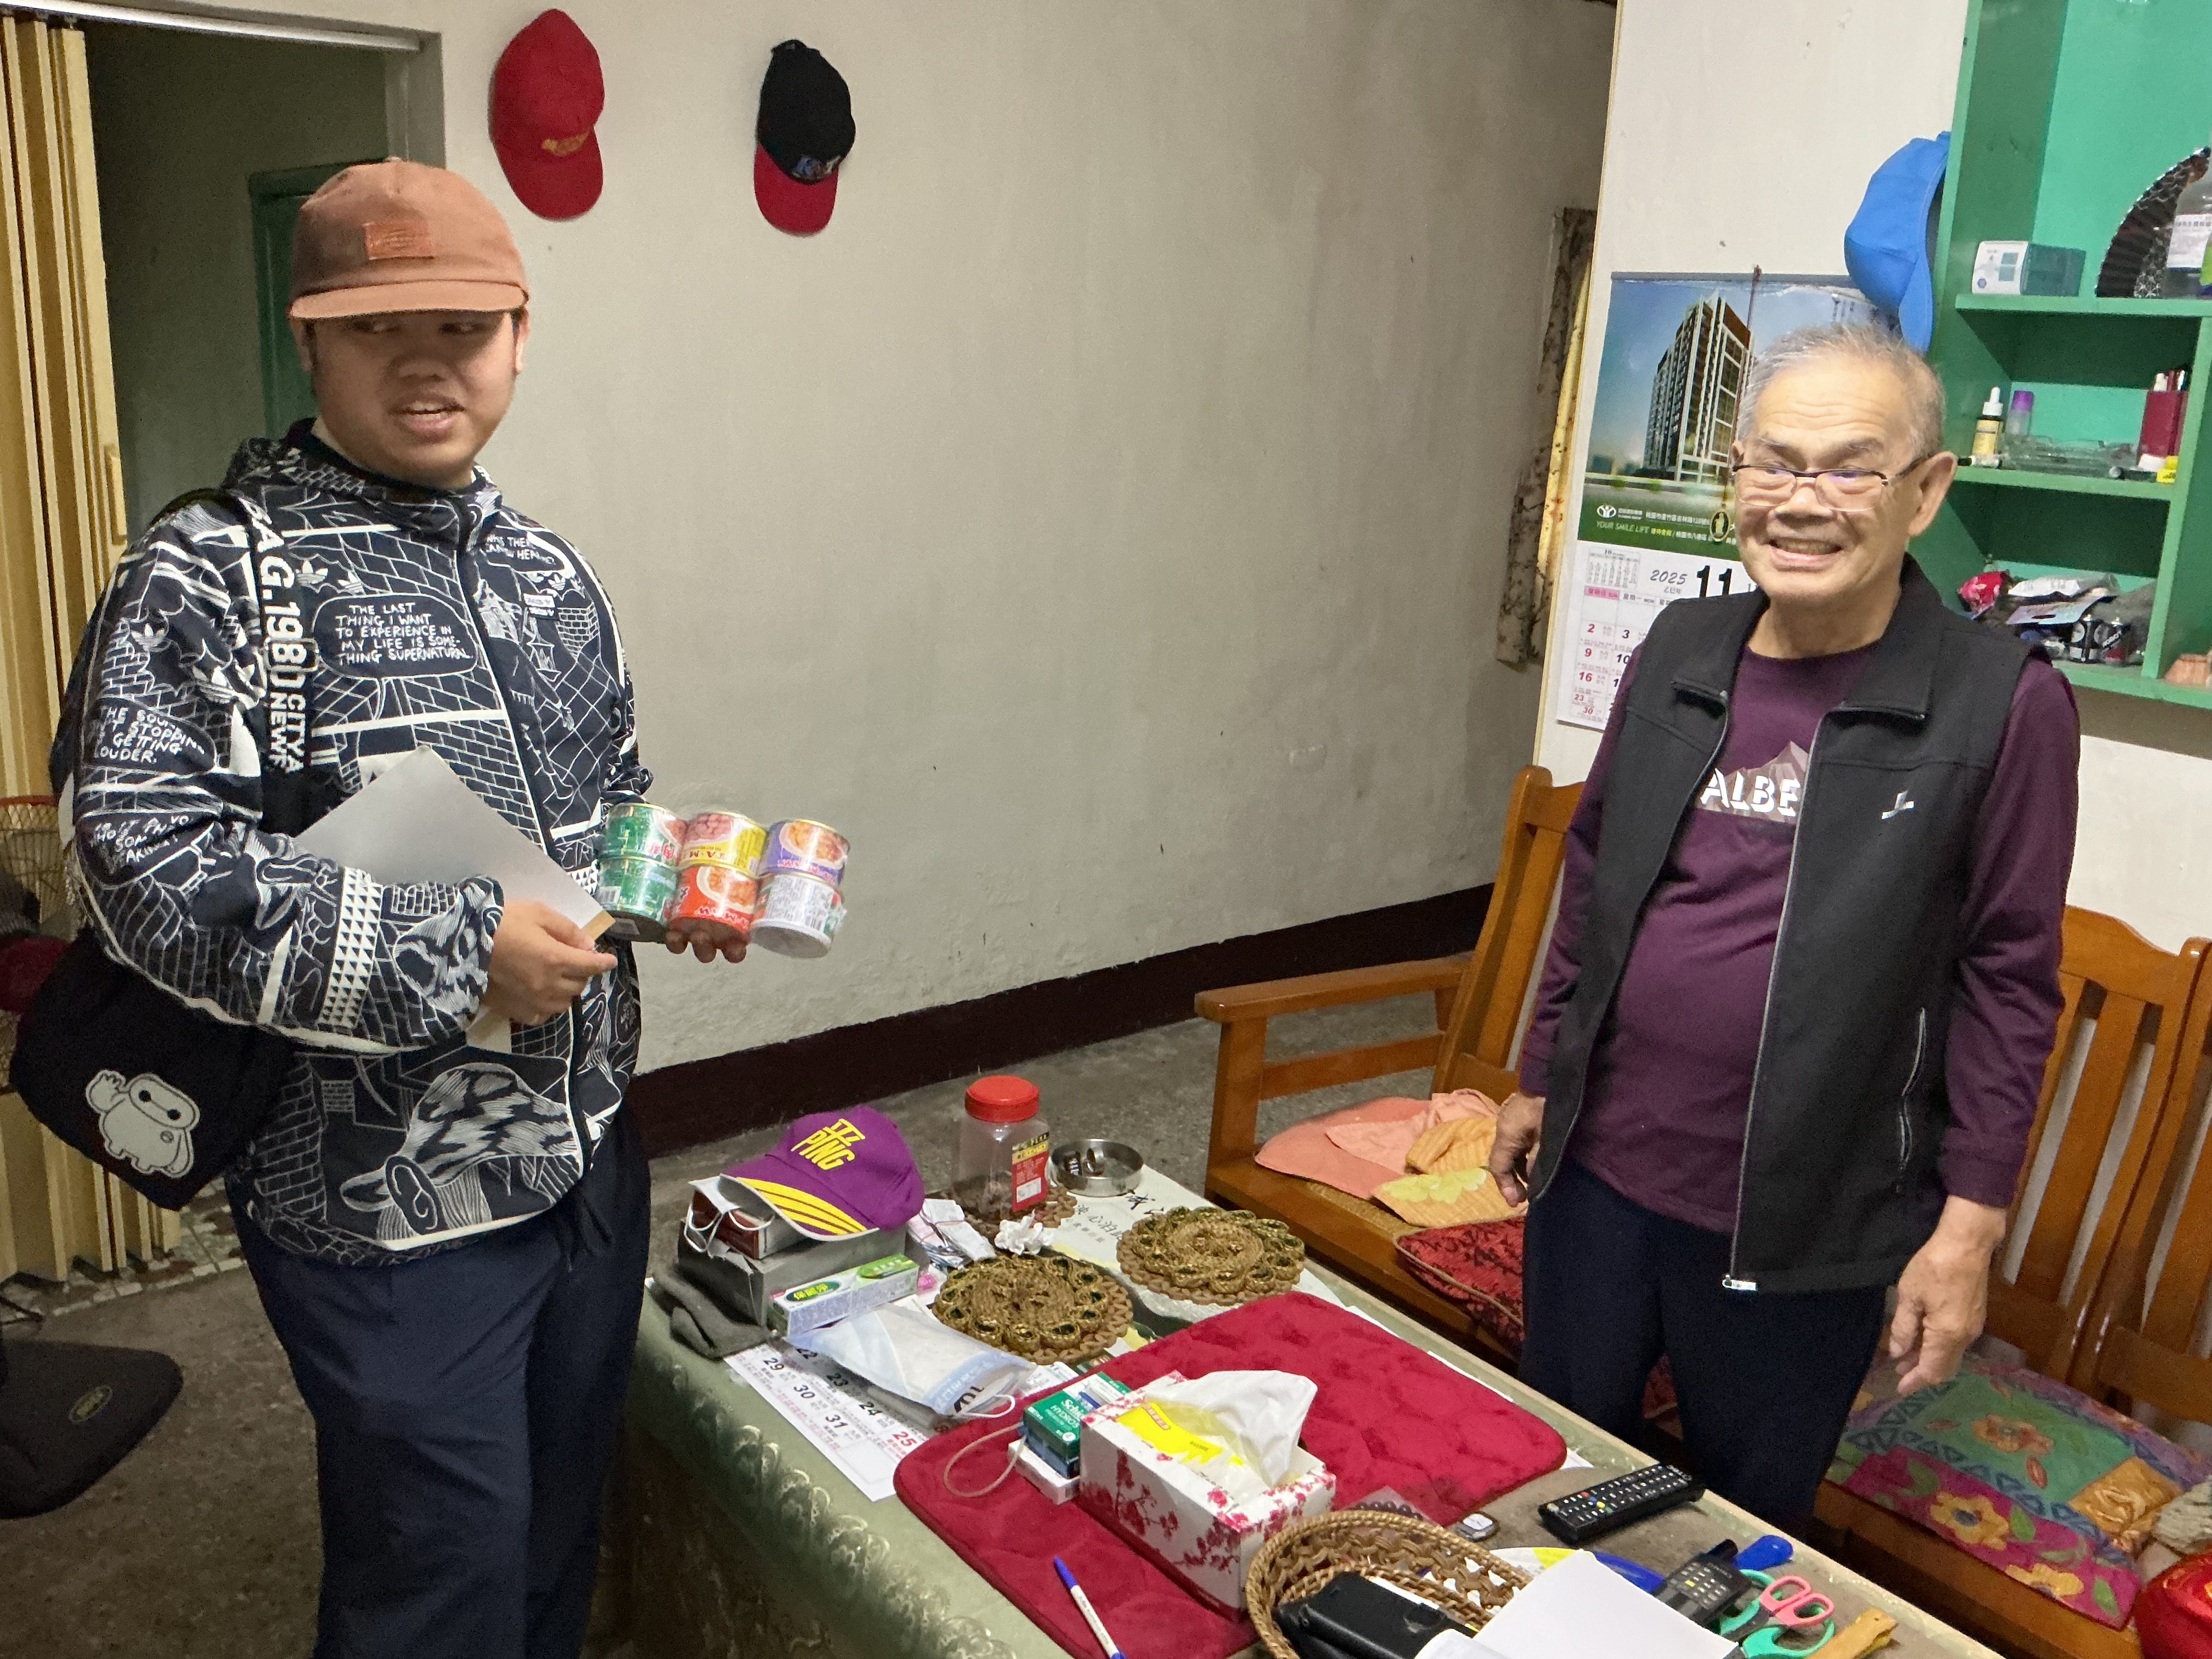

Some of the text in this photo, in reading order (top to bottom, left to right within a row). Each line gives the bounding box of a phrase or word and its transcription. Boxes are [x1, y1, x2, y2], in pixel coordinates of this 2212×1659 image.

[1650, 569, 1688, 585] 2025
[348, 602, 416, 614] THE LAST
[335, 613, 432, 627] THING I WANT
[335, 625, 452, 639] TO EXPERIENCE IN
[1587, 623, 1630, 639] 2 3
[341, 635, 461, 652] MY LIFE IS SOME-
[337, 649, 383, 666] THING
[1584, 648, 1630, 664] 9 10
[1578, 672, 1593, 682] 16
[1574, 693, 1584, 702] 23
[113, 731, 183, 756] GETTING
[822, 1118, 866, 1147] 平
[790, 1129, 856, 1171] PING
[763, 1357, 849, 1429] 29 30 31
[826, 1372, 849, 1387] 23
[858, 1401, 883, 1416] 24
[891, 1431, 918, 1447] 25
